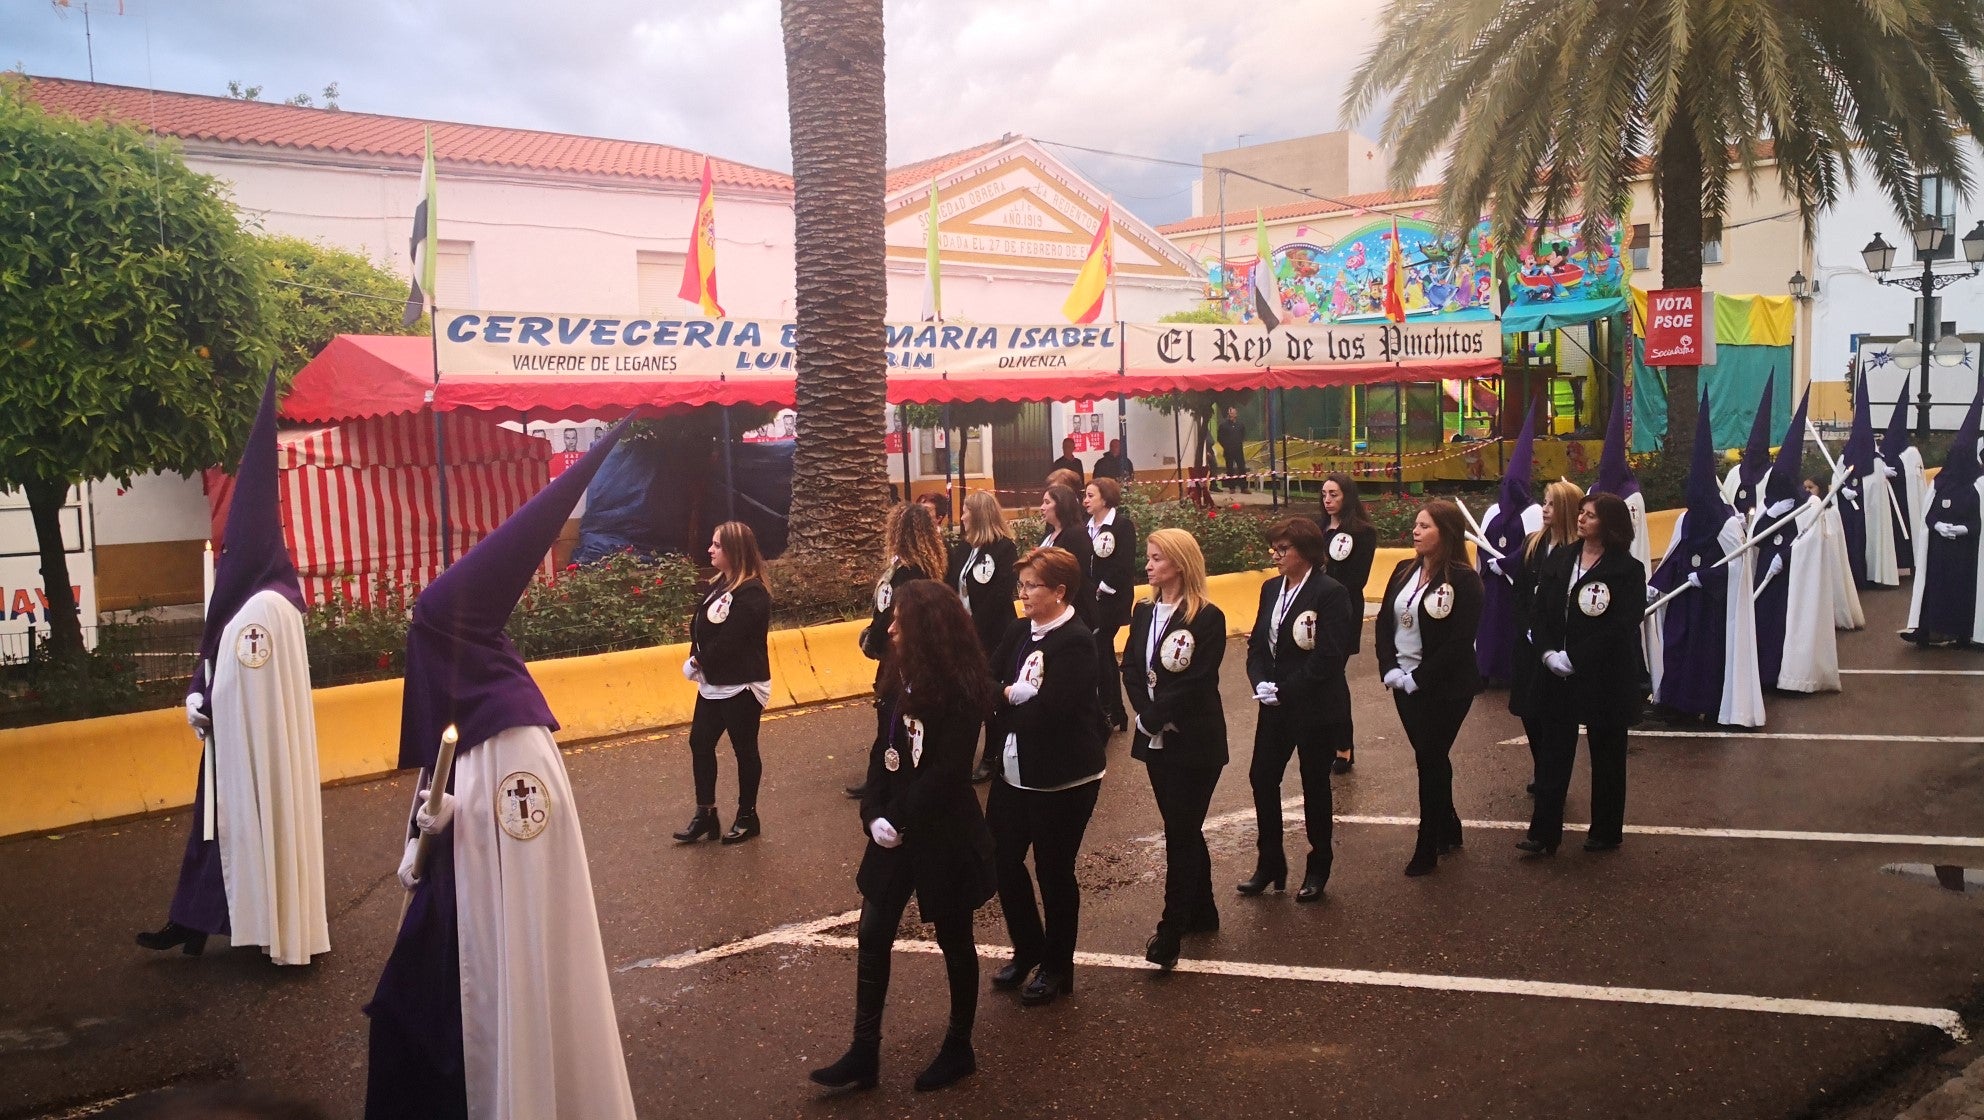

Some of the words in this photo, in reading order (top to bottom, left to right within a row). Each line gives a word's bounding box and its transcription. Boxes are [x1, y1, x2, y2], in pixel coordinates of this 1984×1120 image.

[918, 197, 966, 227] SOIEDAD
[969, 181, 1007, 204] OBRERA
[972, 237, 984, 251] EL
[989, 238, 1000, 251] 27
[1005, 240, 1016, 253] DE
[1020, 241, 1062, 257] FEBRERO
[1066, 245, 1077, 258] DE
[1655, 296, 1693, 311] VOTA
[446, 314, 762, 349] CERVECERIA
[1653, 314, 1694, 329] PSOE
[886, 324, 998, 350] MARIA
[1008, 326, 1115, 350] ISABEL
[1157, 327, 1196, 364] El
[1212, 327, 1273, 367] Rey
[1285, 330, 1314, 362] de
[1328, 330, 1366, 362] los
[1379, 325, 1484, 363] Pinchitos
[512, 354, 585, 372] VALVERDE
[589, 355, 613, 372] DE
[615, 355, 677, 372] LEGANES
[736, 350, 796, 371] LUI
[998, 355, 1067, 369] OLIVENZA
